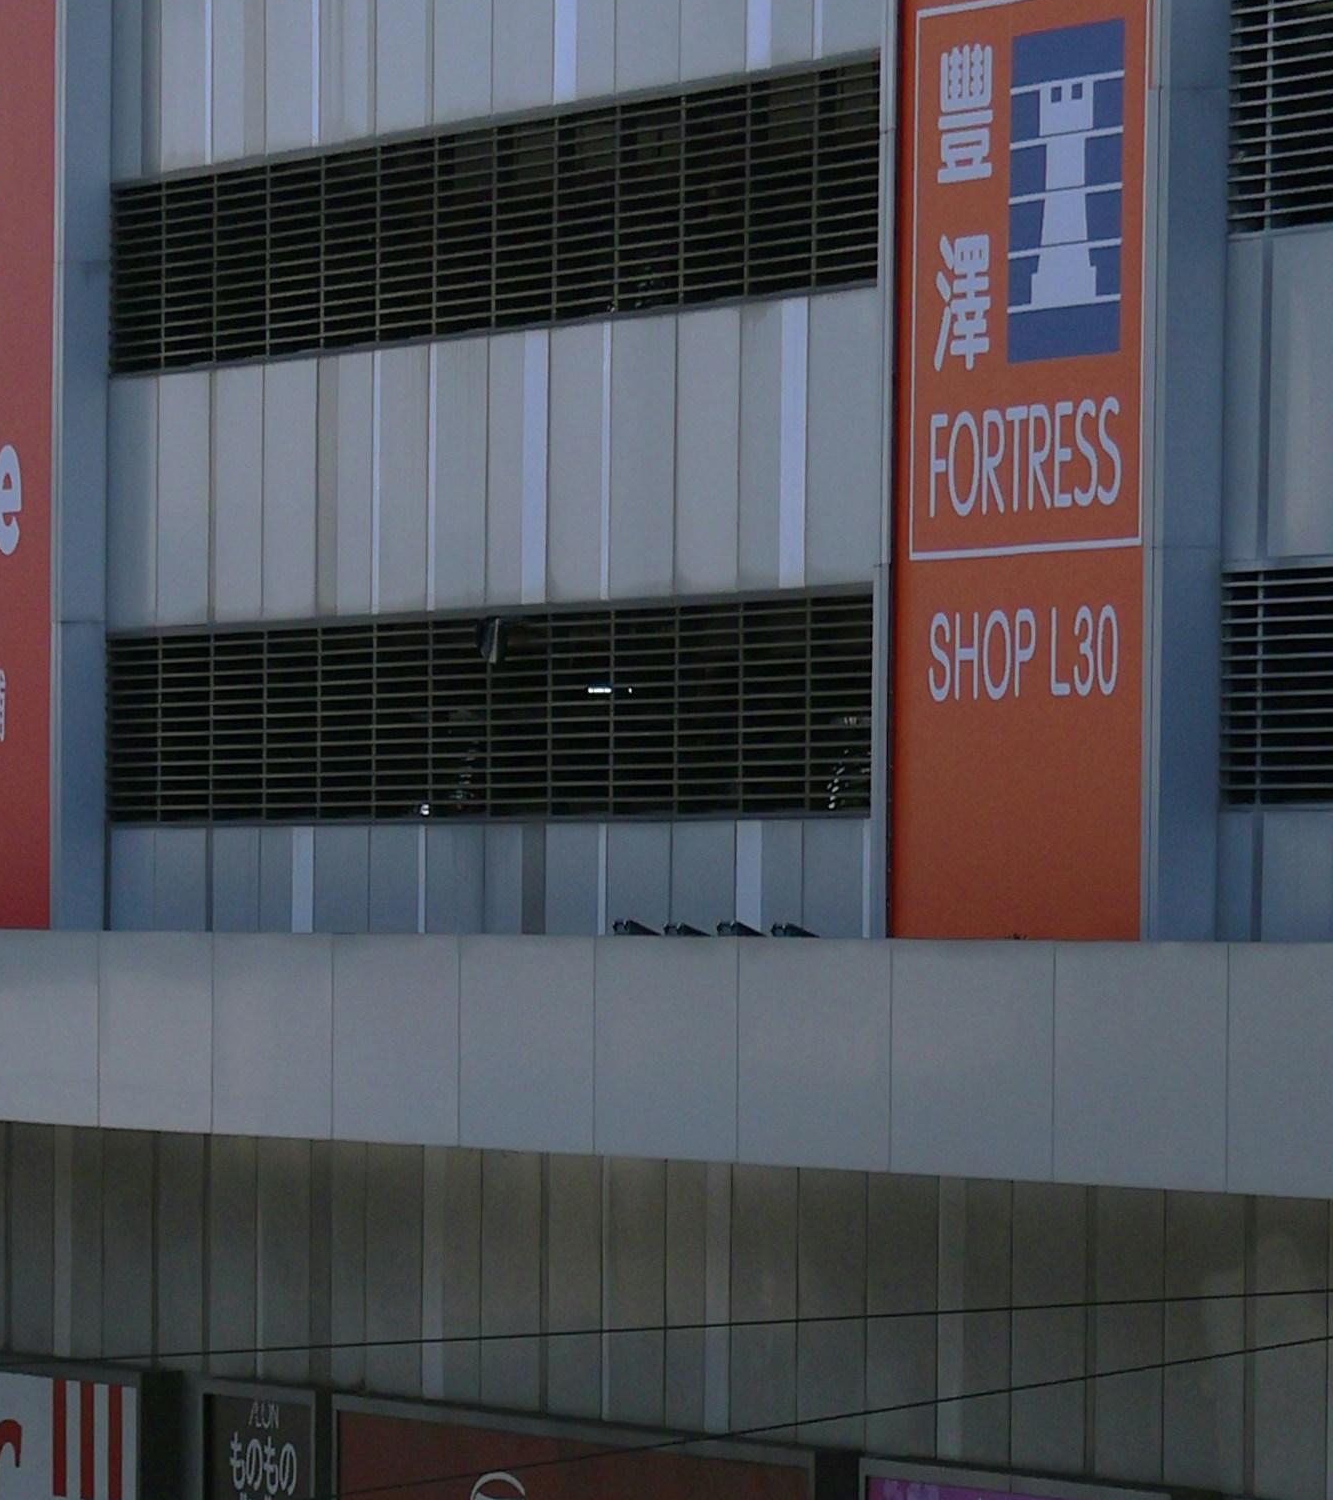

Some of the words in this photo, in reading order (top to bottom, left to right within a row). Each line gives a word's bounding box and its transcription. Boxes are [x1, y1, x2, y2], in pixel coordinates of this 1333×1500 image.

[933, 43, 994, 372] 豐澤
[929, 395, 1122, 520] FORTRESS
[927, 607, 1034, 703] SHOP
[1049, 602, 1120, 698] L30
[229, 1431, 298, 1497] ものもの
